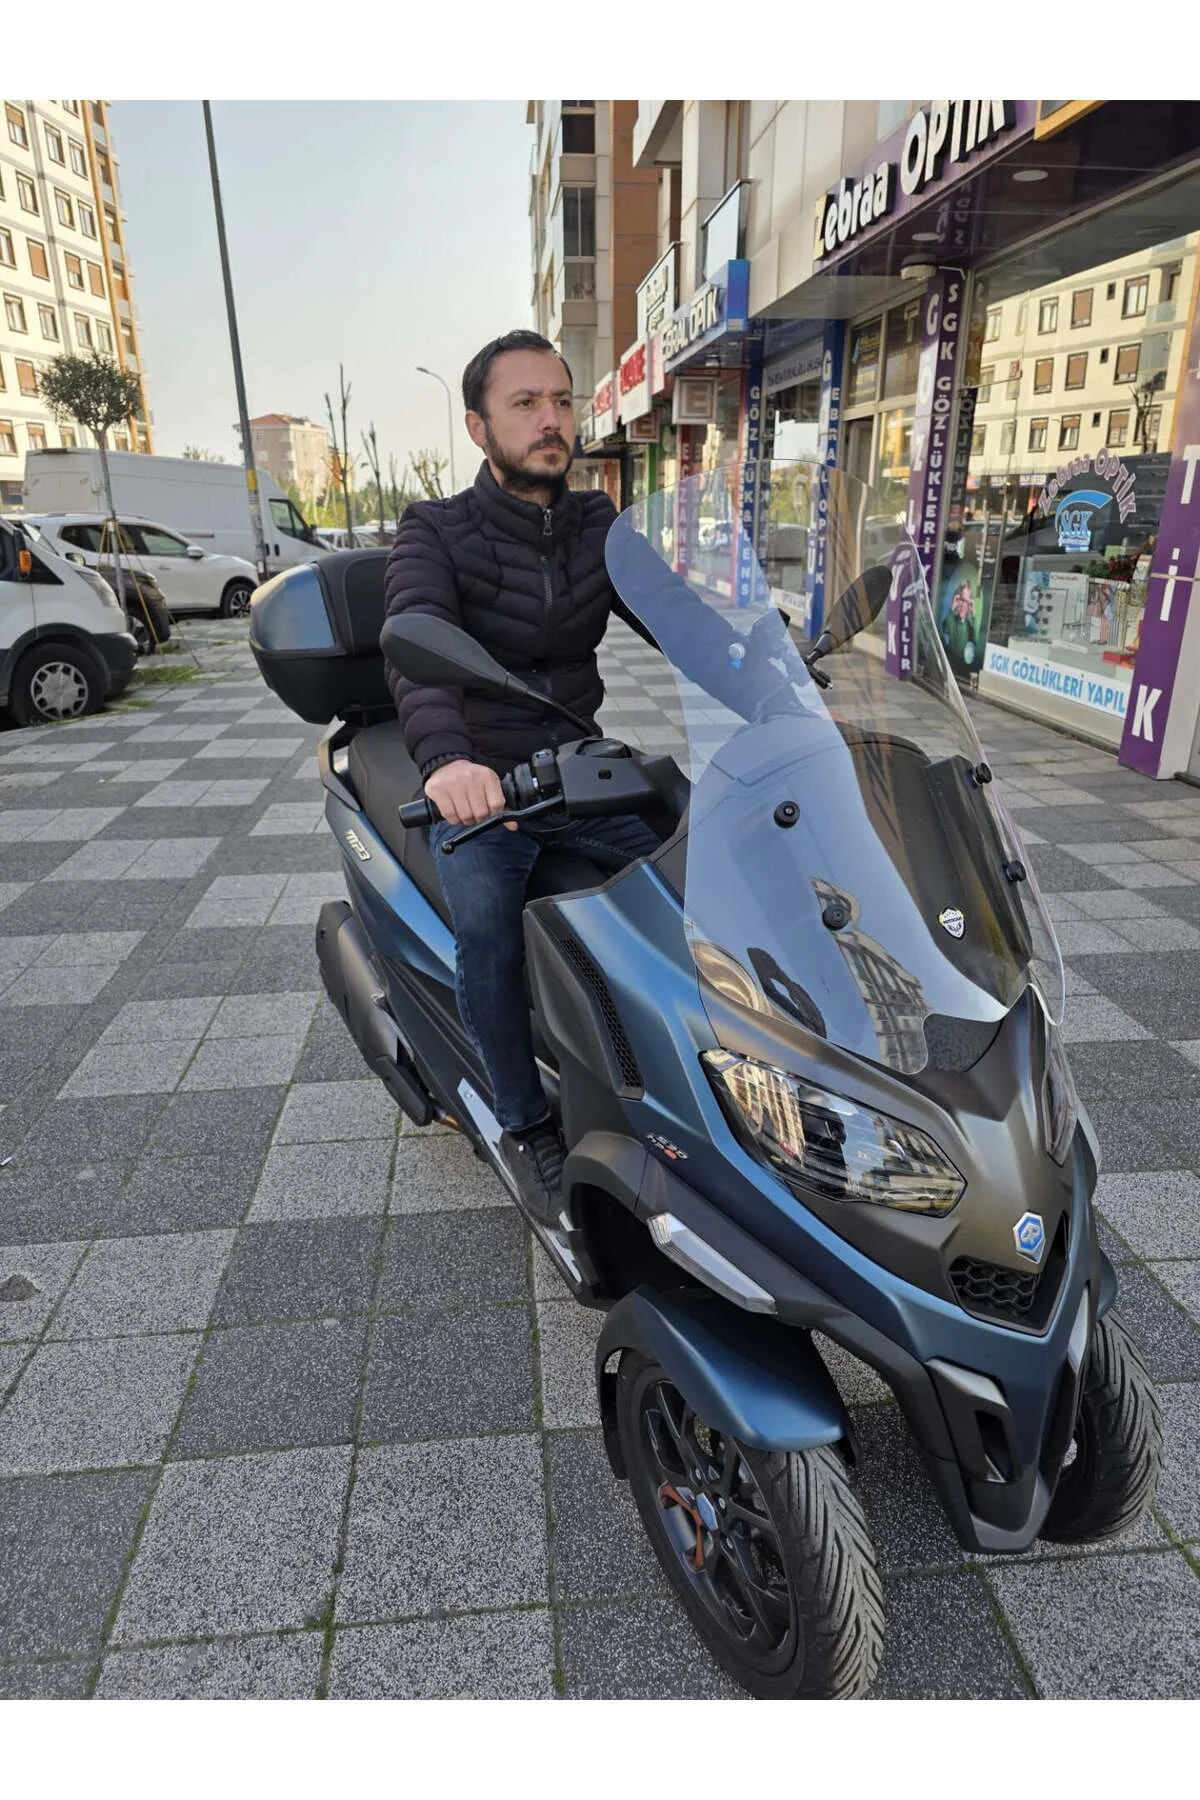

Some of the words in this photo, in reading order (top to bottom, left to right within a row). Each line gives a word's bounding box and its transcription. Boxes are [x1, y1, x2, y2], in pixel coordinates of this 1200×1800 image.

[813, 161, 889, 261] Zebraa
[940, 283, 959, 361] SGK
[1060, 510, 1094, 533] SGK
[1131, 357, 1200, 743] TİK
[991, 653, 1010, 674] SGK
[1011, 657, 1084, 699] GÖZLÜKLERİ
